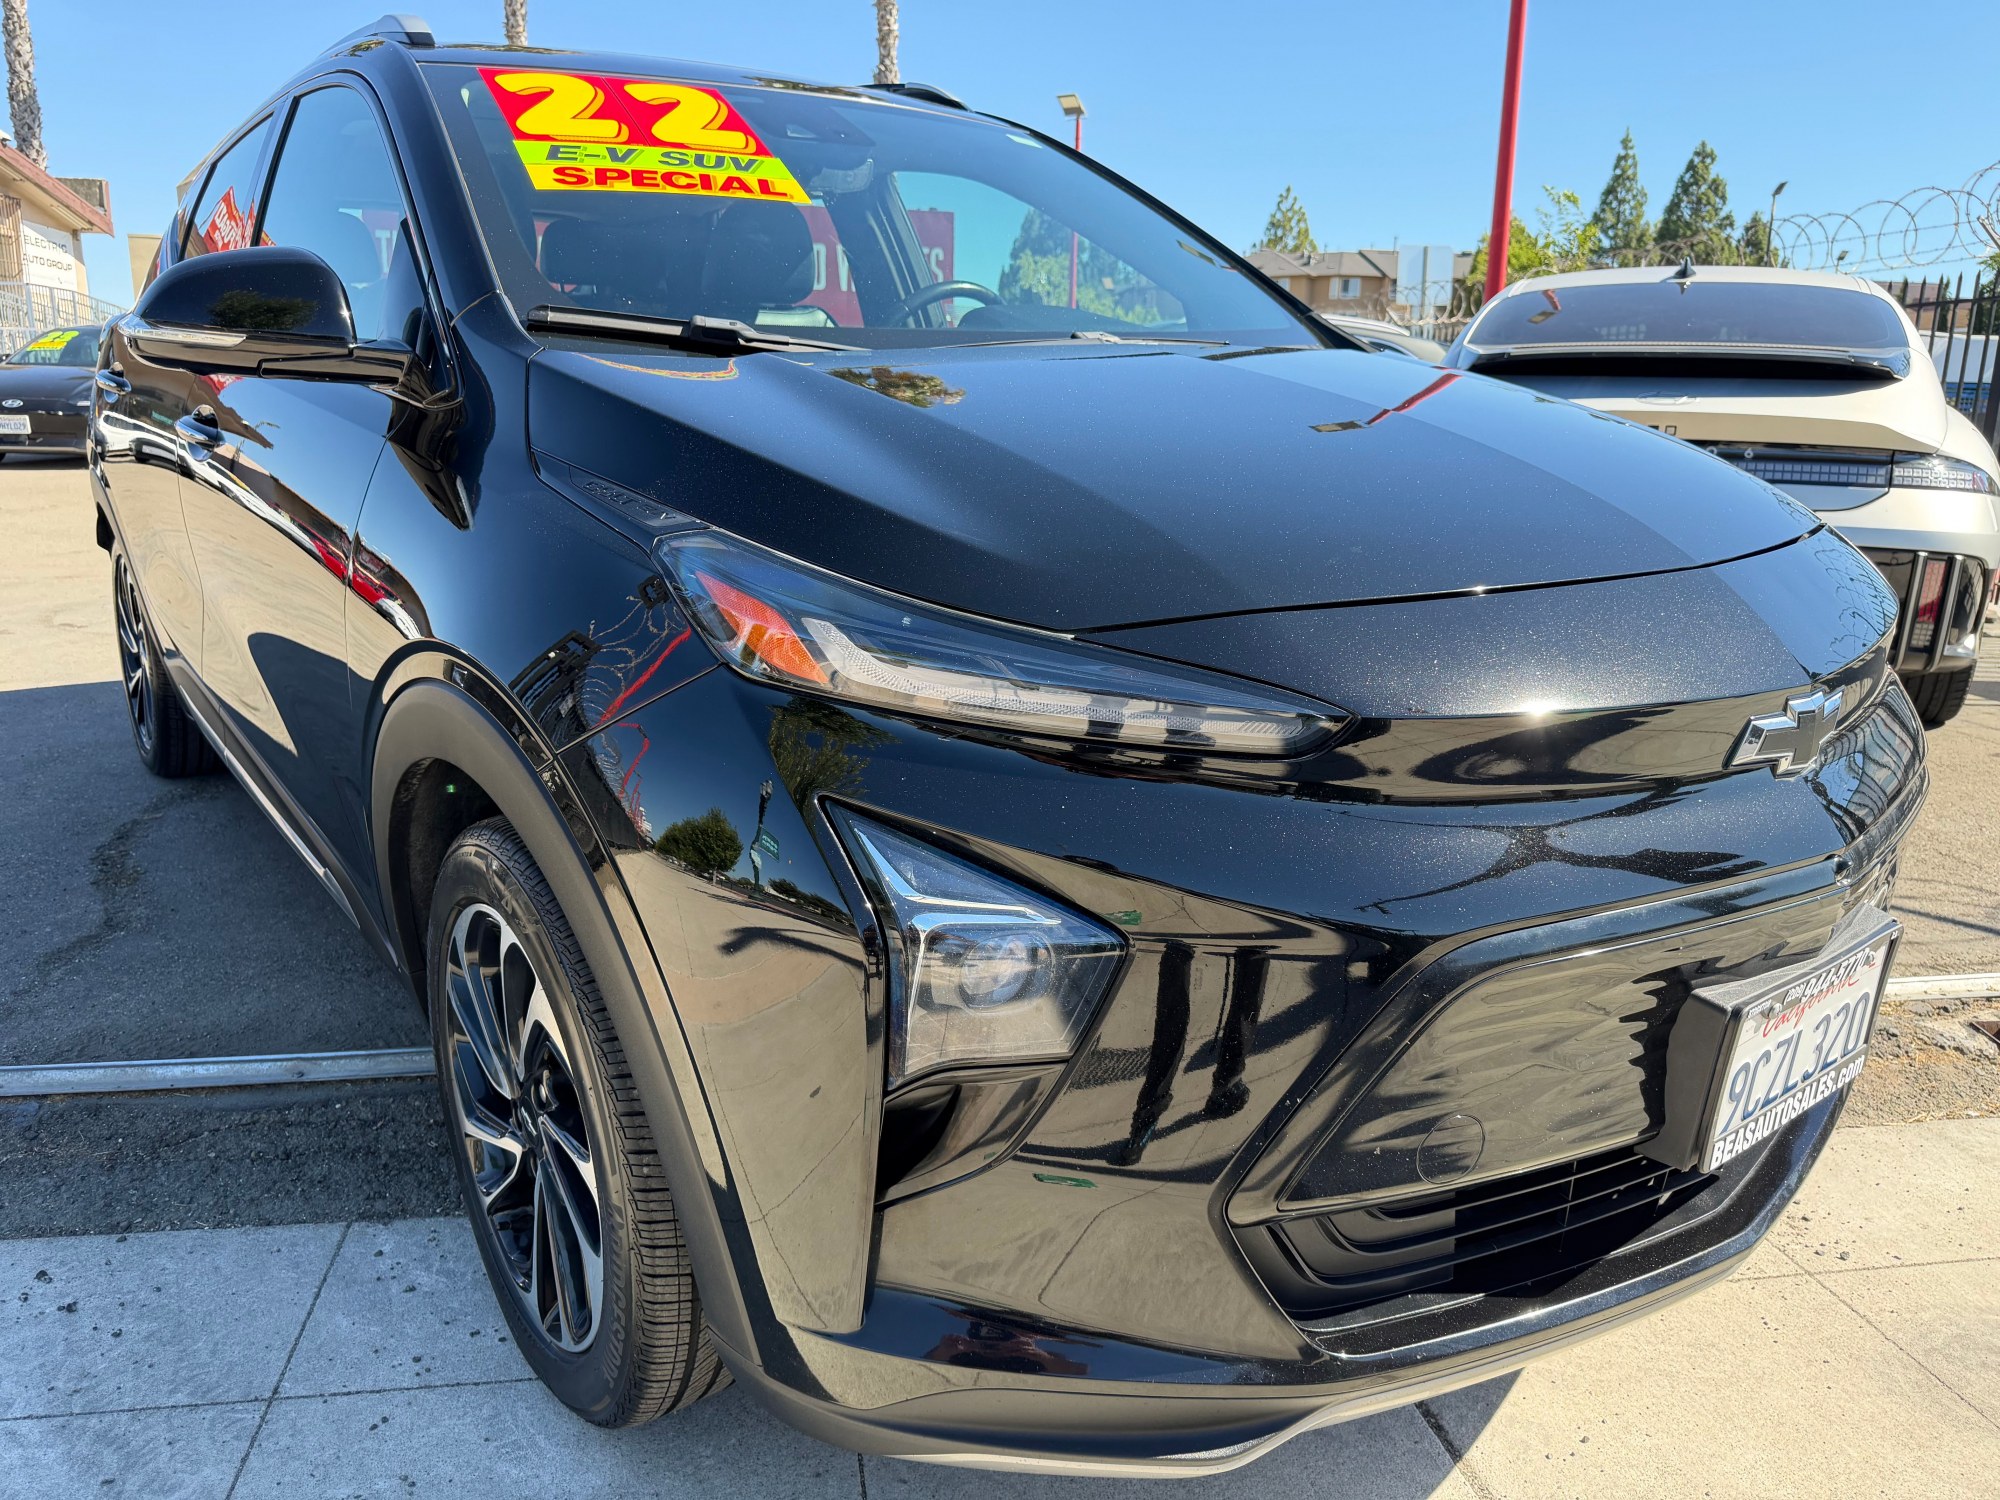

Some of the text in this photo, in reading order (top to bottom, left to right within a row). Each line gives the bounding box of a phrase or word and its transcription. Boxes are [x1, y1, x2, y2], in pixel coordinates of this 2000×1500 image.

[493, 73, 757, 155] 22
[545, 145, 766, 174] E-V SUV
[552, 166, 794, 200] SPECIAL
[24, 235, 67, 253] ELECTRIC
[22, 253, 72, 270] AUTO GROUP
[1718, 990, 1871, 1137] 9CZL320
